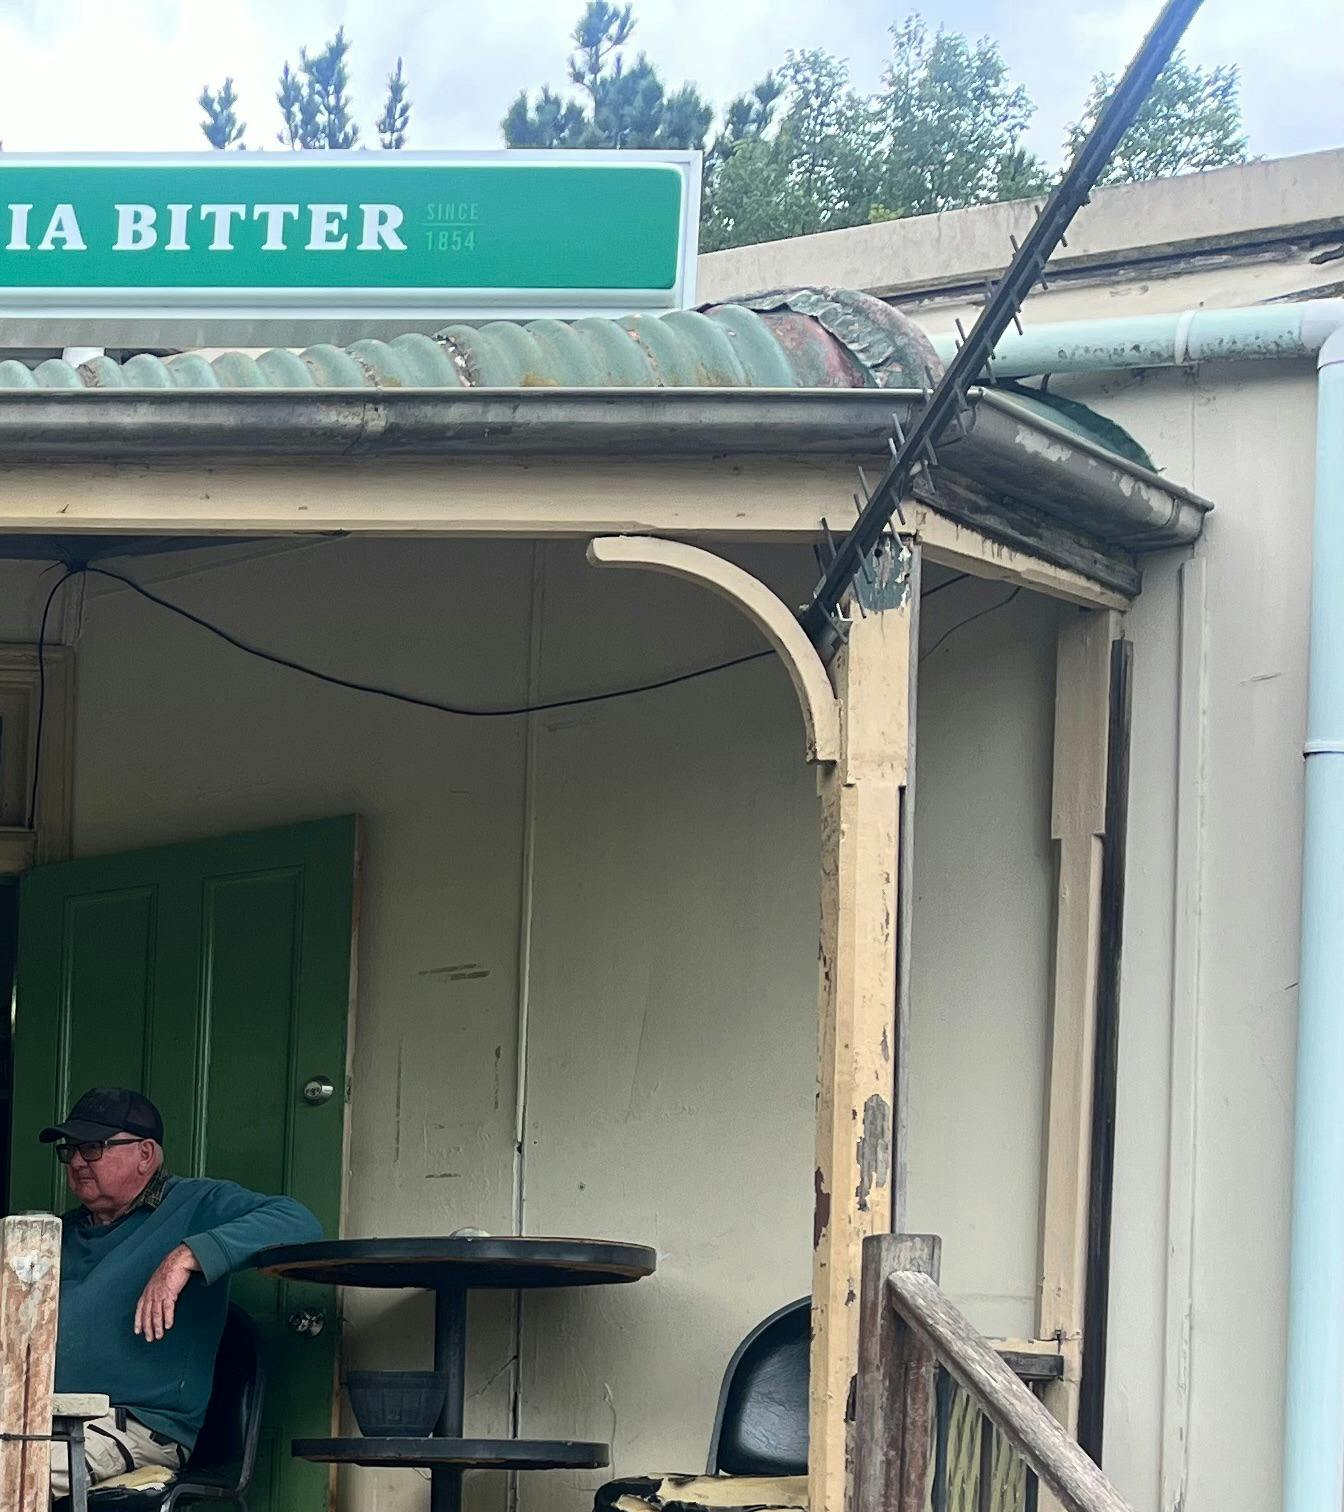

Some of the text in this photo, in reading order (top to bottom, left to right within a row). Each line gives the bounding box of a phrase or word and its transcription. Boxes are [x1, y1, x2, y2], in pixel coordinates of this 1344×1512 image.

[426, 202, 479, 220] SINCE
[112, 203, 407, 251] BITTER
[425, 231, 475, 251] 1854
